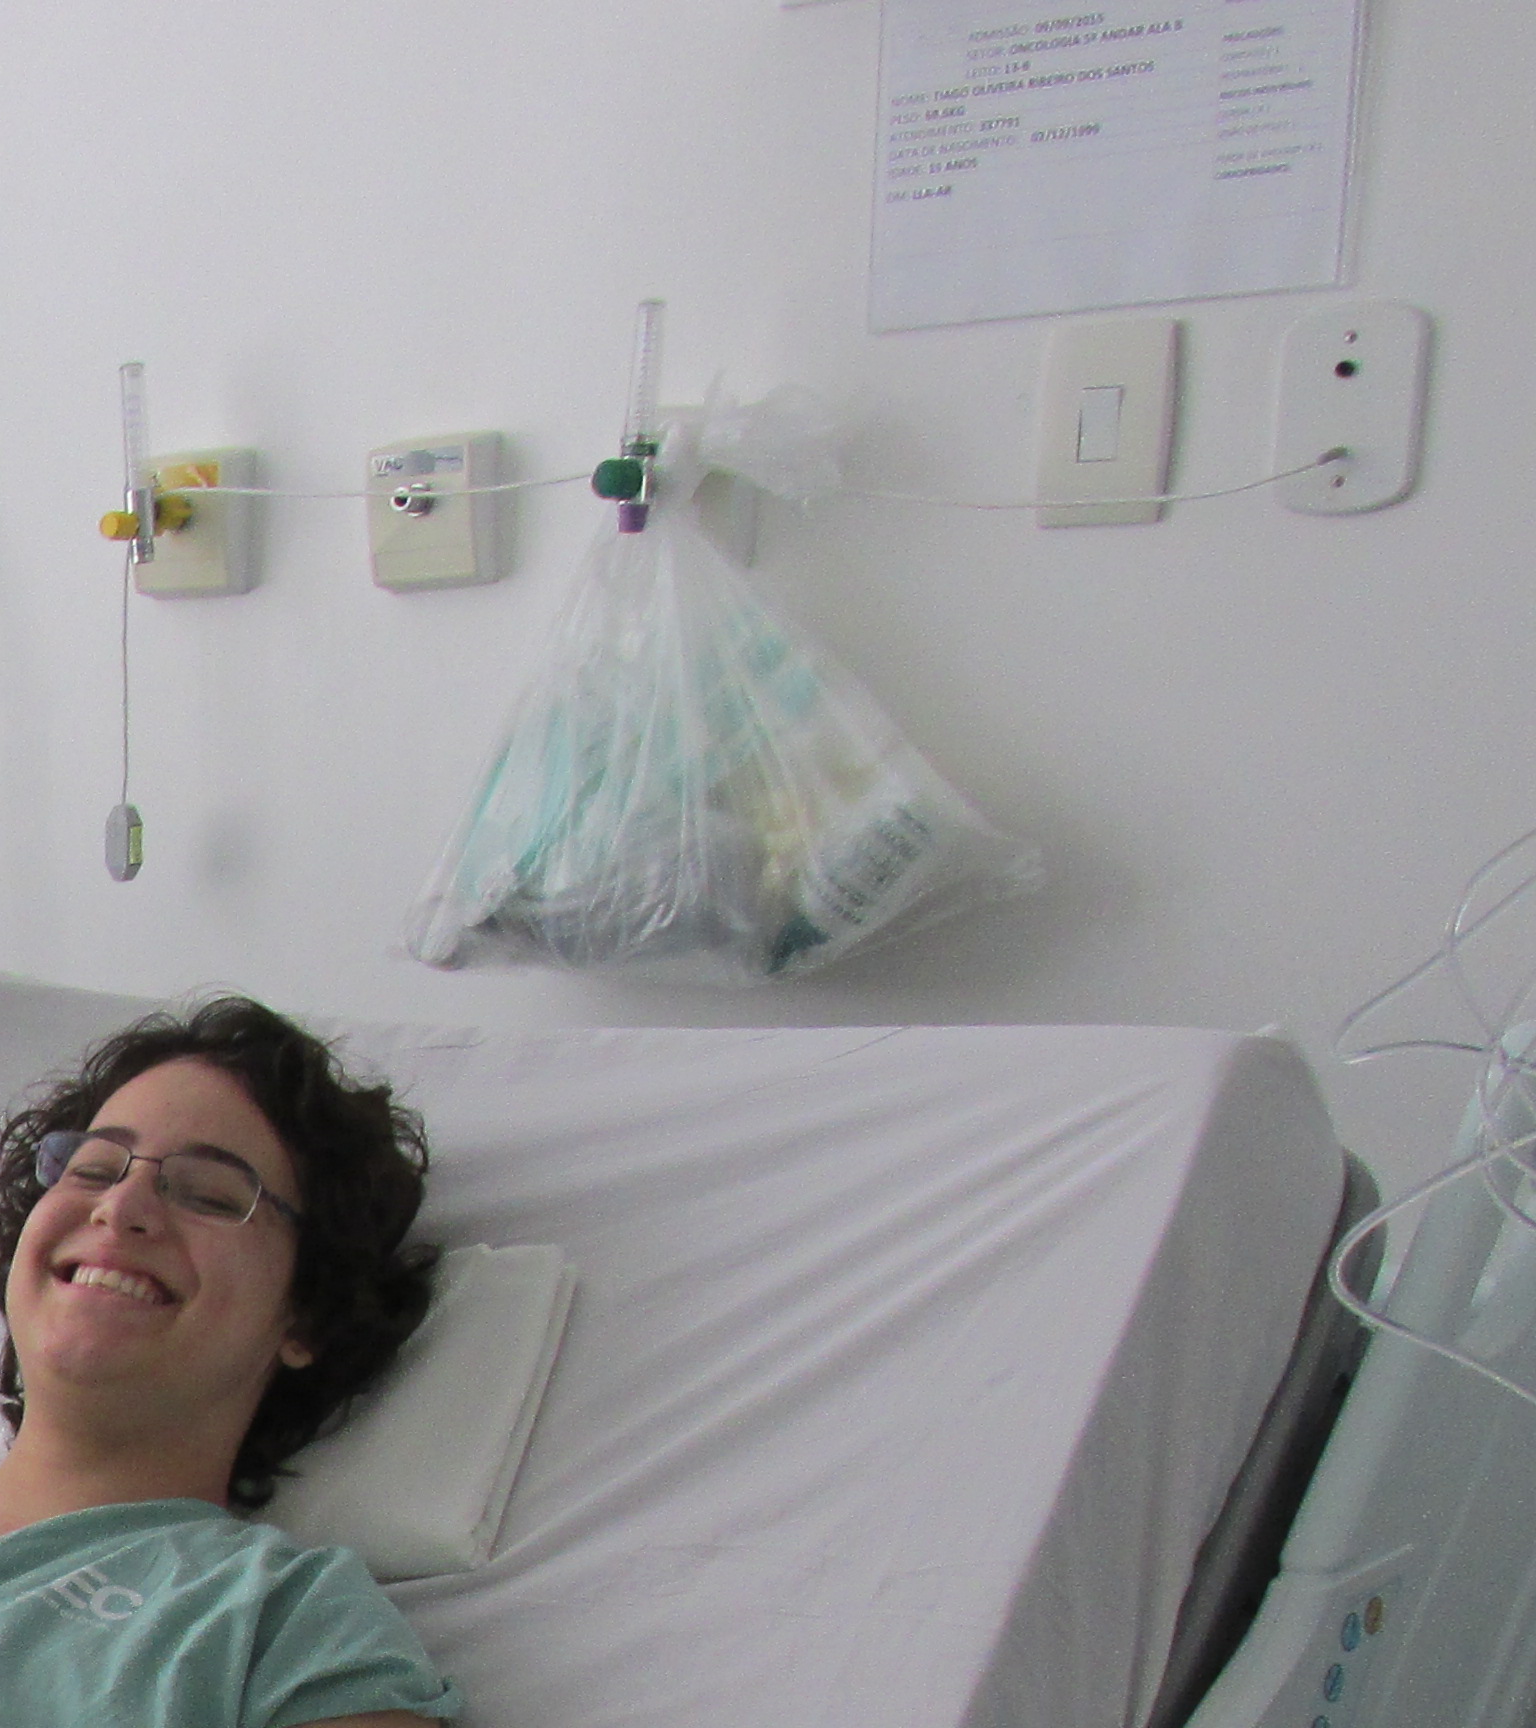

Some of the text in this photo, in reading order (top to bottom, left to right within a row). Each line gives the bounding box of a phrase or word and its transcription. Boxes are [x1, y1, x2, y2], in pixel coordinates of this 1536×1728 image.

[1009, 34, 1080, 55] ONCOLOGIA
[1100, 25, 1145, 43] ANDAR
[1146, 20, 1172, 36] ALA
[971, 78, 1025, 97] OLIVEIRA
[1077, 66, 1104, 83] DOS
[1105, 59, 1156, 78] SANTOS
[944, 156, 978, 172] ANOS
